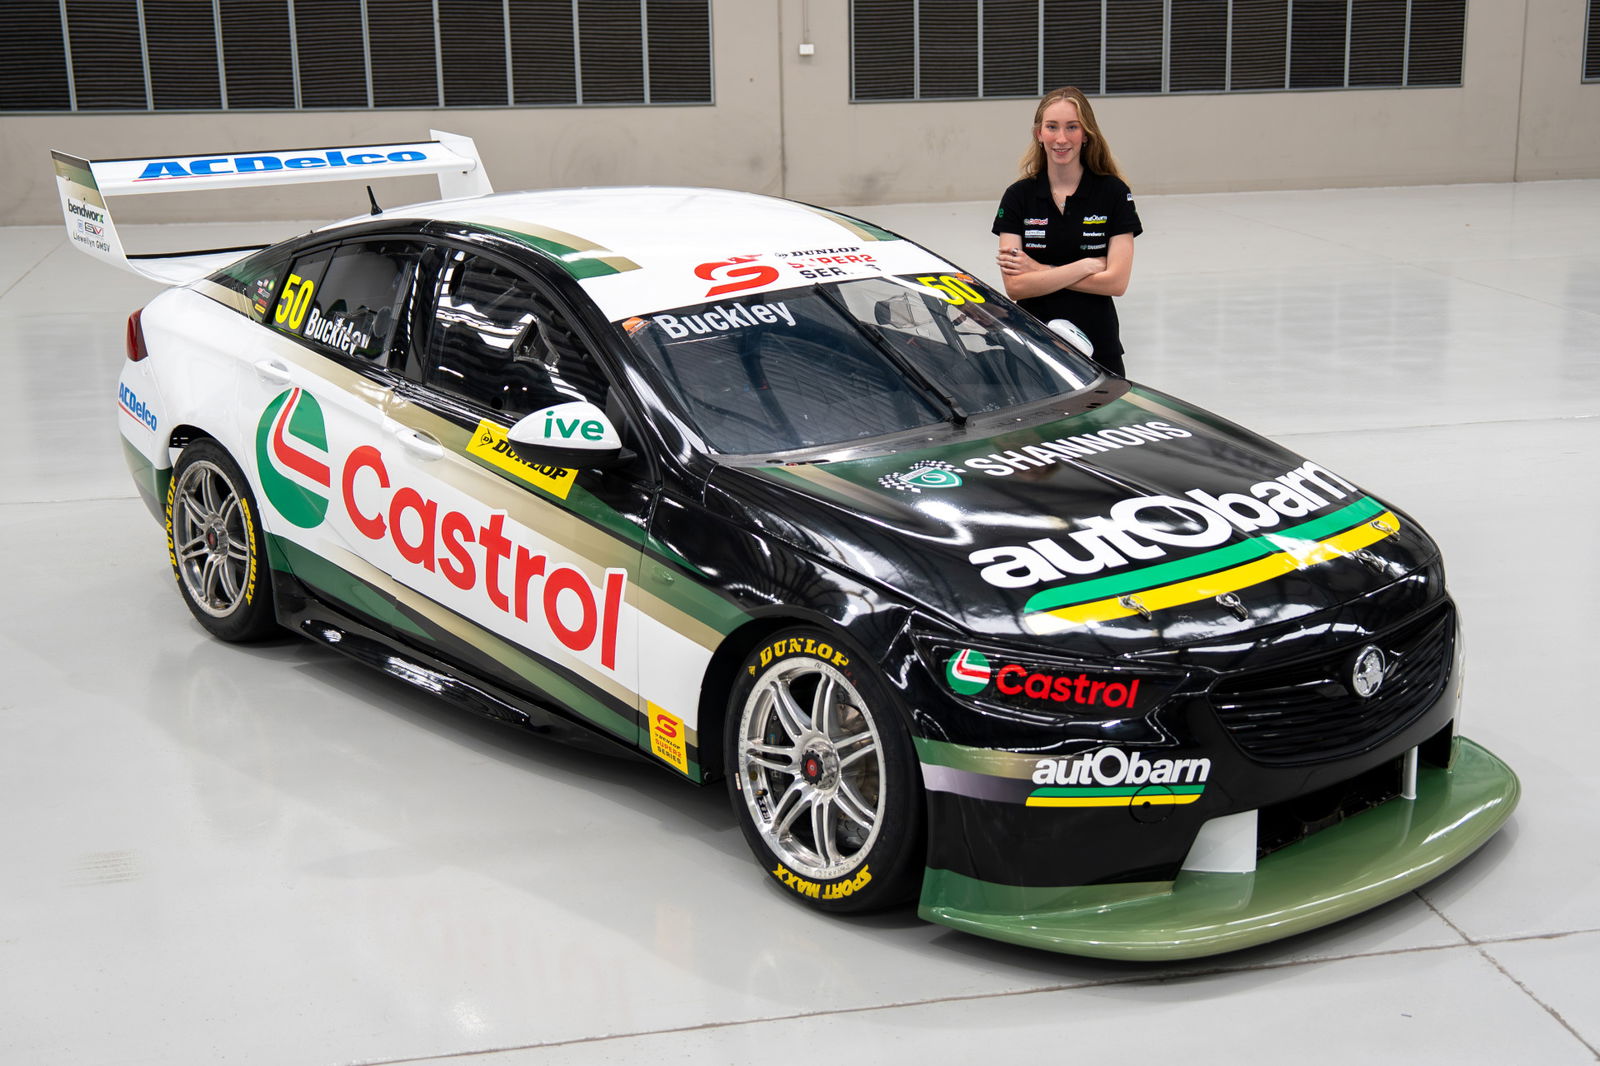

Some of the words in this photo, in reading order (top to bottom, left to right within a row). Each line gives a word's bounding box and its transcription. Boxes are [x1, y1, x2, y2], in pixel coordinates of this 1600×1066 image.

[137, 151, 428, 179] ACDelco
[790, 246, 860, 257] DUNLOP
[274, 273, 315, 330] 50
[915, 275, 986, 306] 50
[652, 301, 797, 339] Buckley
[118, 381, 158, 432] ACDelco
[543, 410, 605, 441] ive
[963, 421, 1193, 477] SHANNONS
[165, 474, 178, 567] DUNLOP
[342, 444, 625, 671] Castrol
[759, 637, 849, 668] DUNLOP
[995, 663, 1140, 709] Castrol
[655, 738, 682, 759] SUPER2
[657, 745, 682, 765] SERIES
[772, 863, 821, 899] MAXX
[822, 864, 878, 900] SPORT
